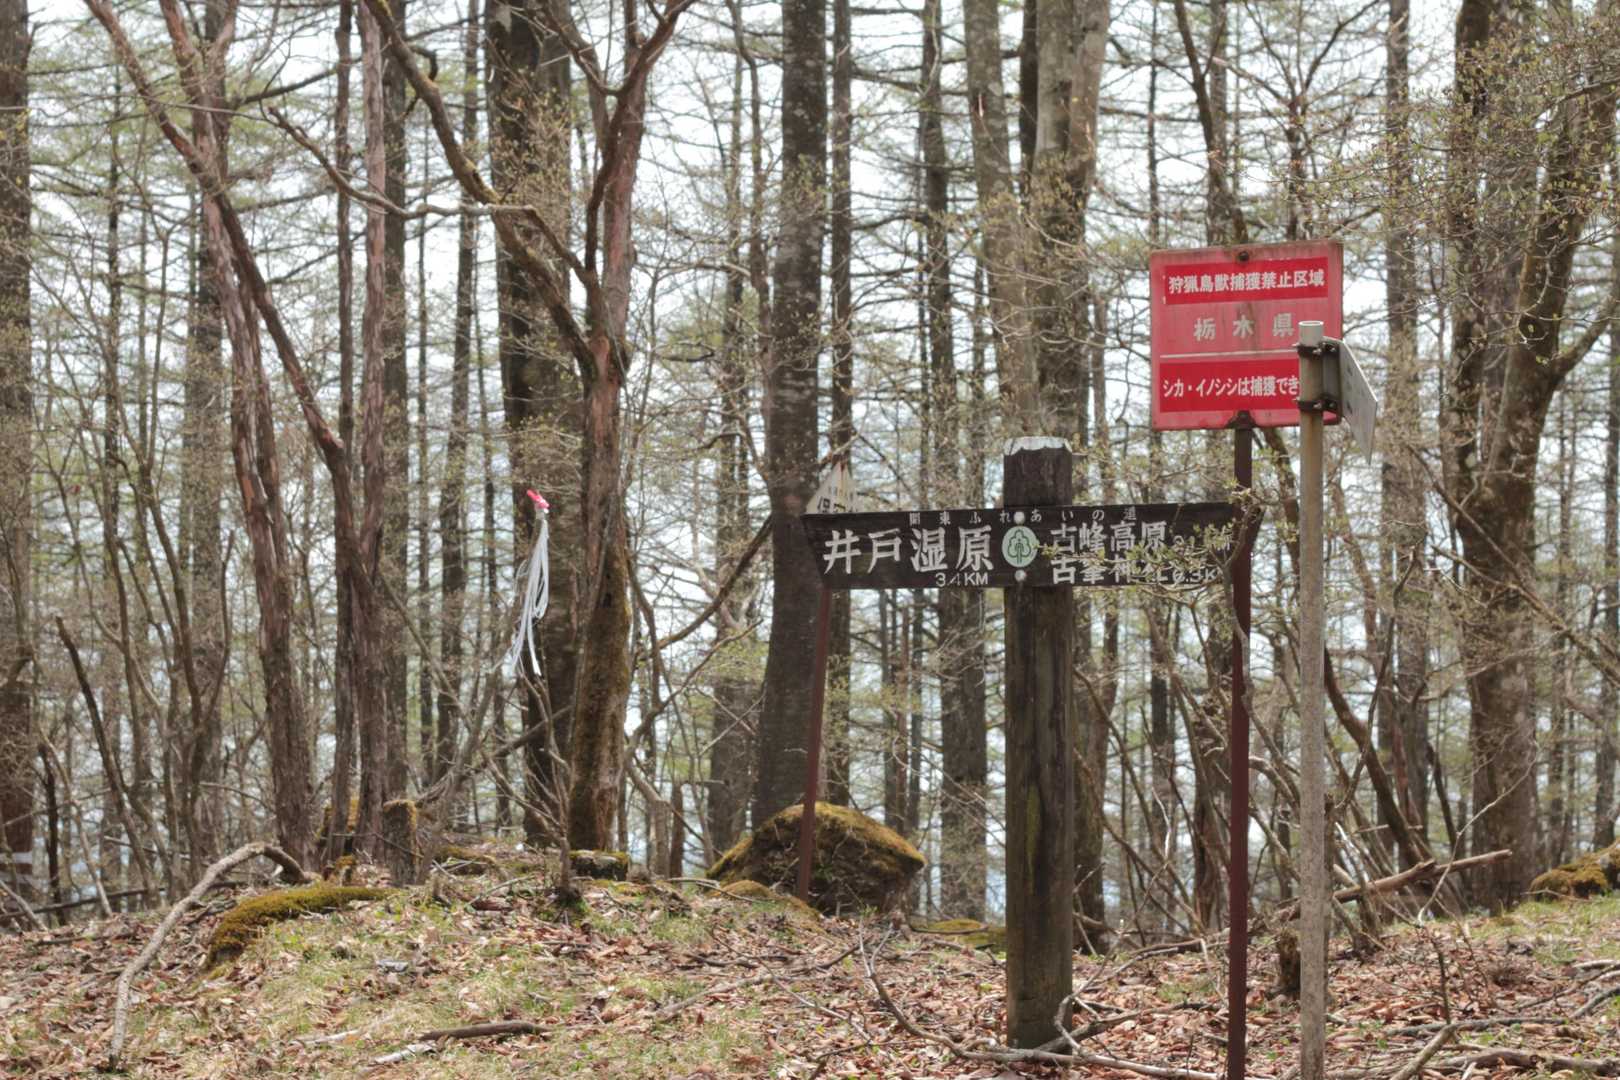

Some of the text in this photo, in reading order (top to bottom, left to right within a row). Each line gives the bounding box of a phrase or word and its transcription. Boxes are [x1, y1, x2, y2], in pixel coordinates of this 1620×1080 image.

[1168, 268, 1325, 295] 狩猟鳥獣捕獲禁止区域
[1194, 312, 1294, 341] 栃木県
[823, 524, 994, 575] 井戸湿原
[1050, 520, 1168, 553] 古峰高原
